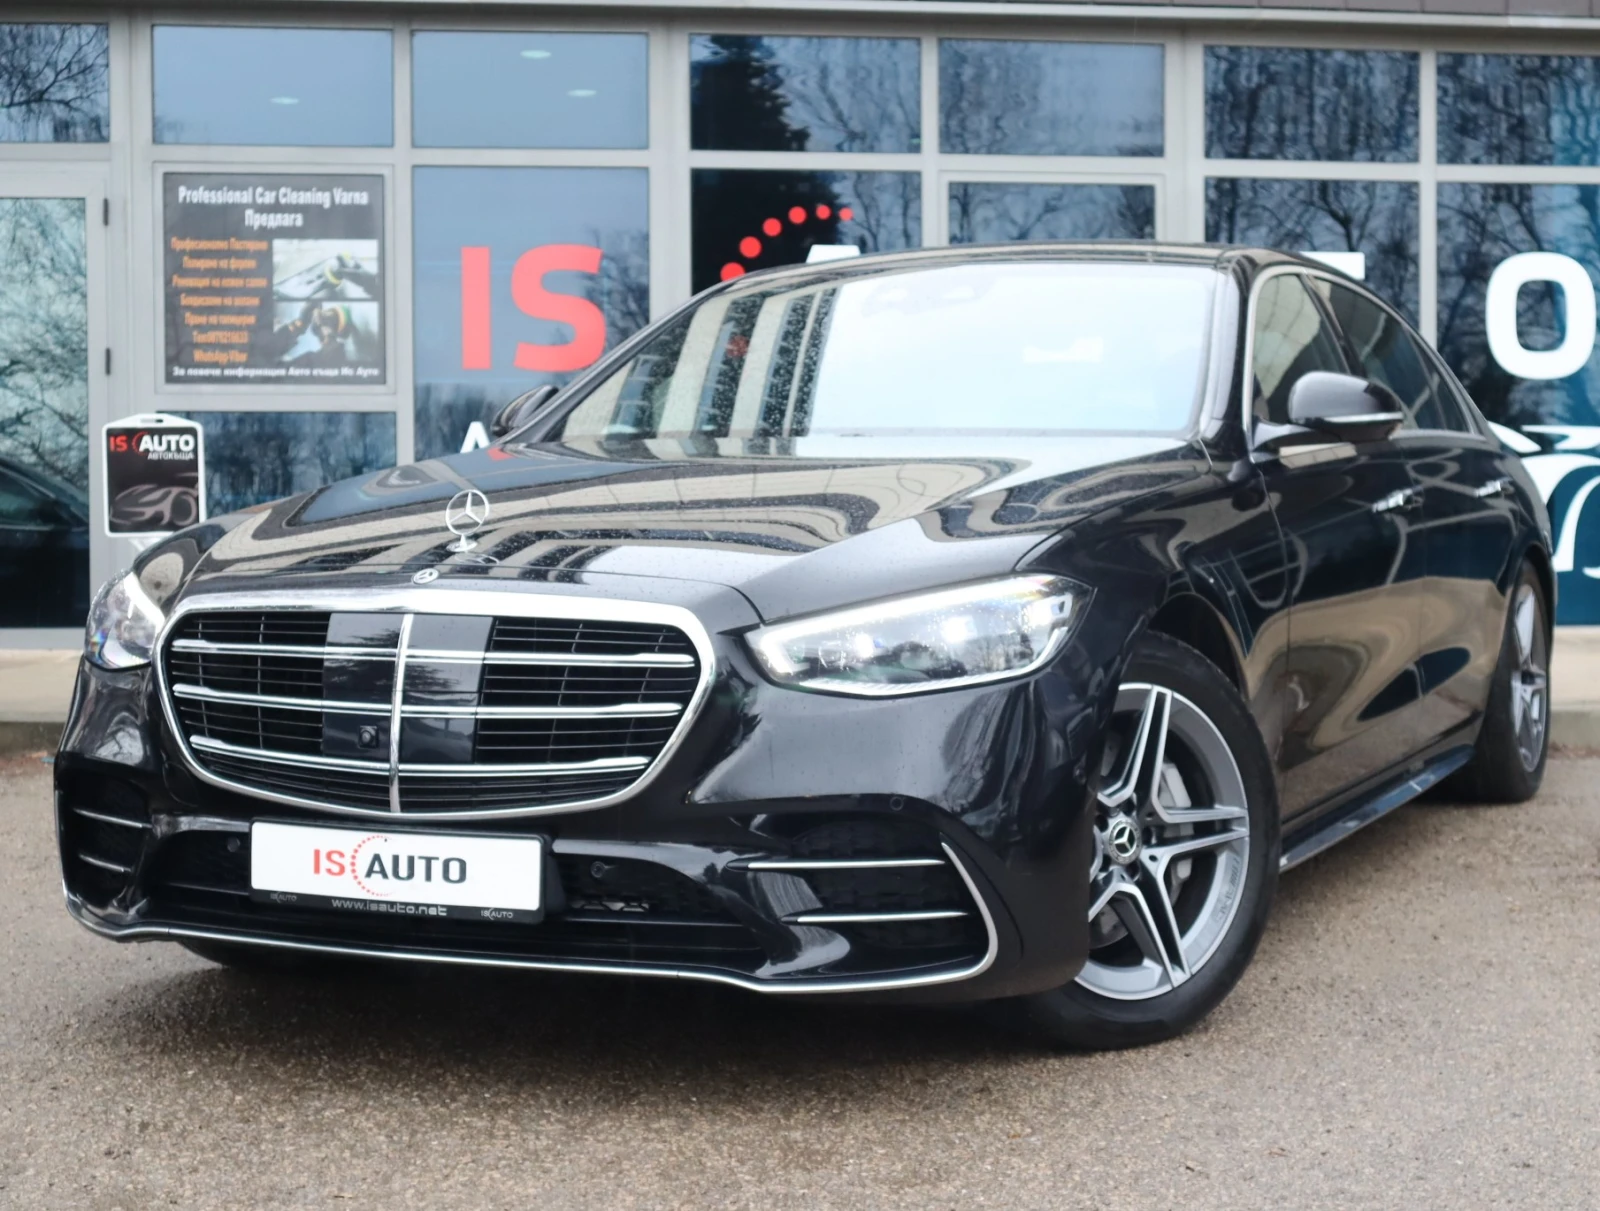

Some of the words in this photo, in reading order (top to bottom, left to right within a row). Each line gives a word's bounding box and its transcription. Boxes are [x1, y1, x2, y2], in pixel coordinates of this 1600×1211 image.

[178, 185, 253, 204] Professional
[255, 186, 276, 204] Car
[279, 186, 331, 209] Cleaning
[333, 187, 369, 205] Varna
[245, 208, 304, 230] Предлага
[461, 243, 607, 373] IS
[172, 366, 185, 376] За
[109, 434, 128, 452] IS
[139, 434, 195, 452] AUTO
[147, 451, 194, 460] АВТОКЪЩА
[313, 848, 346, 877] IS
[364, 853, 467, 884] AUTO
[331, 898, 447, 916] www.isauto.net
